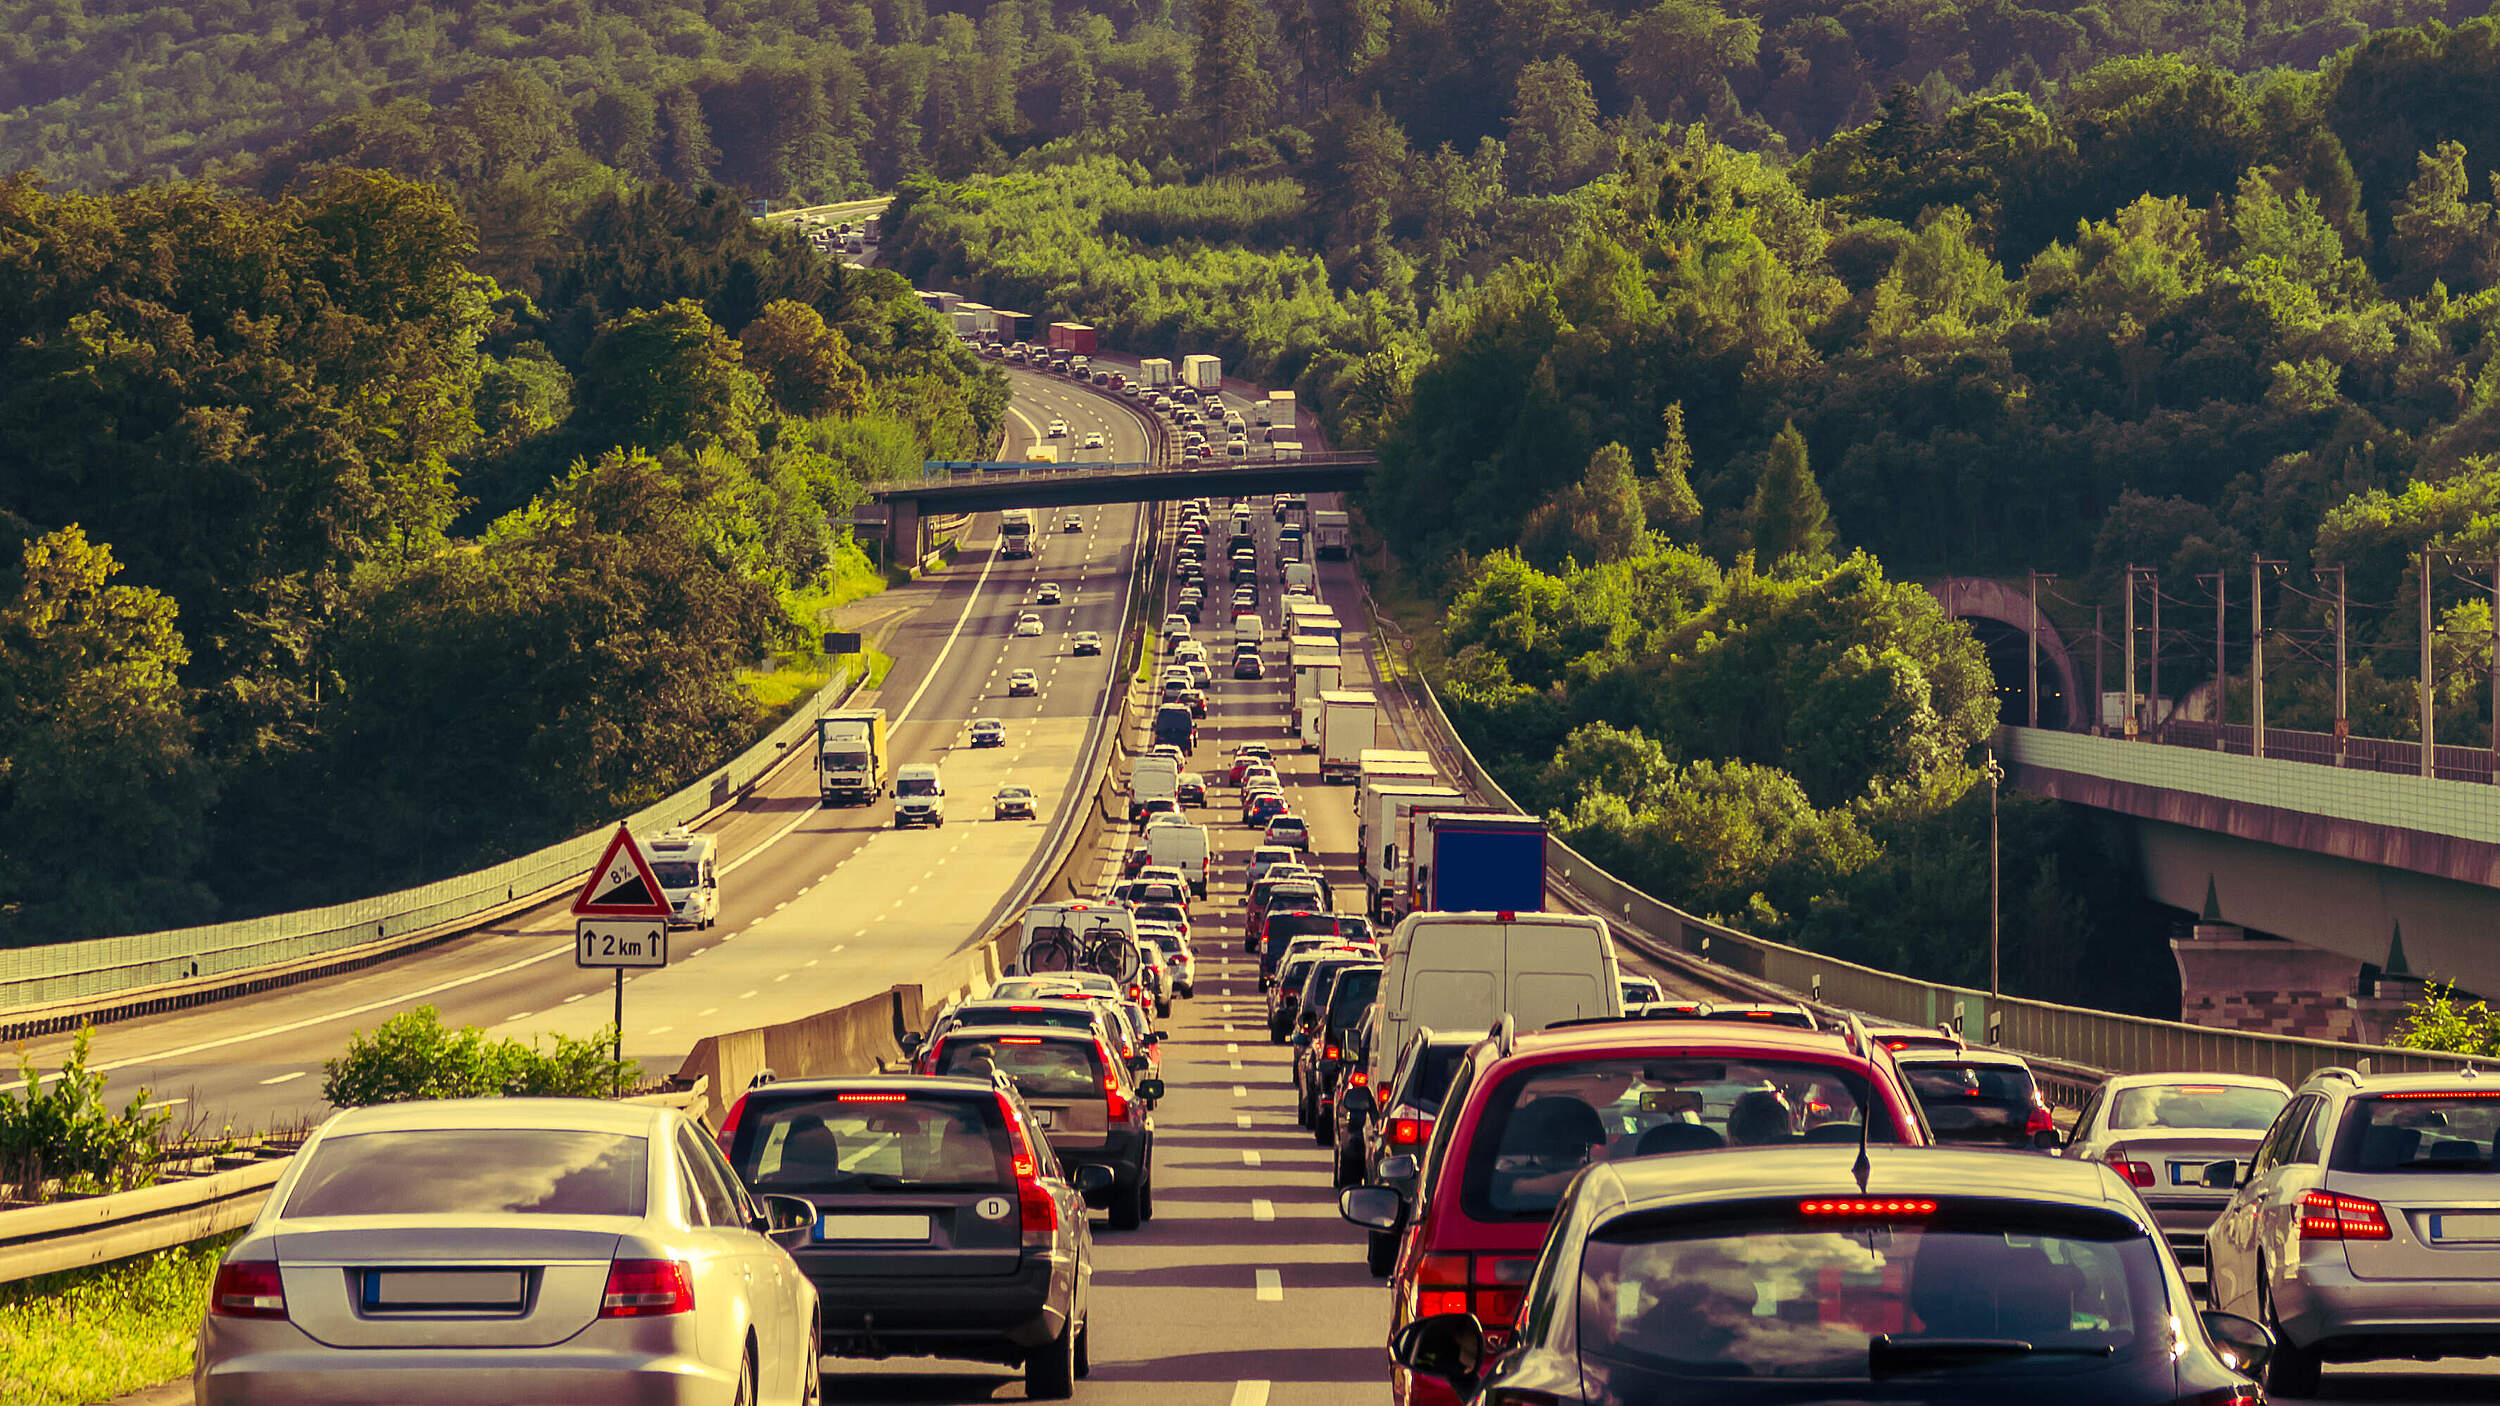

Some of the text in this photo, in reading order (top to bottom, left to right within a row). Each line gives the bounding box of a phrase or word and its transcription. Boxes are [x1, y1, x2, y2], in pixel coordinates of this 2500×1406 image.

[610, 864, 632, 884] 8%
[602, 934, 641, 956] 2 km
[988, 1201, 999, 1215] D
